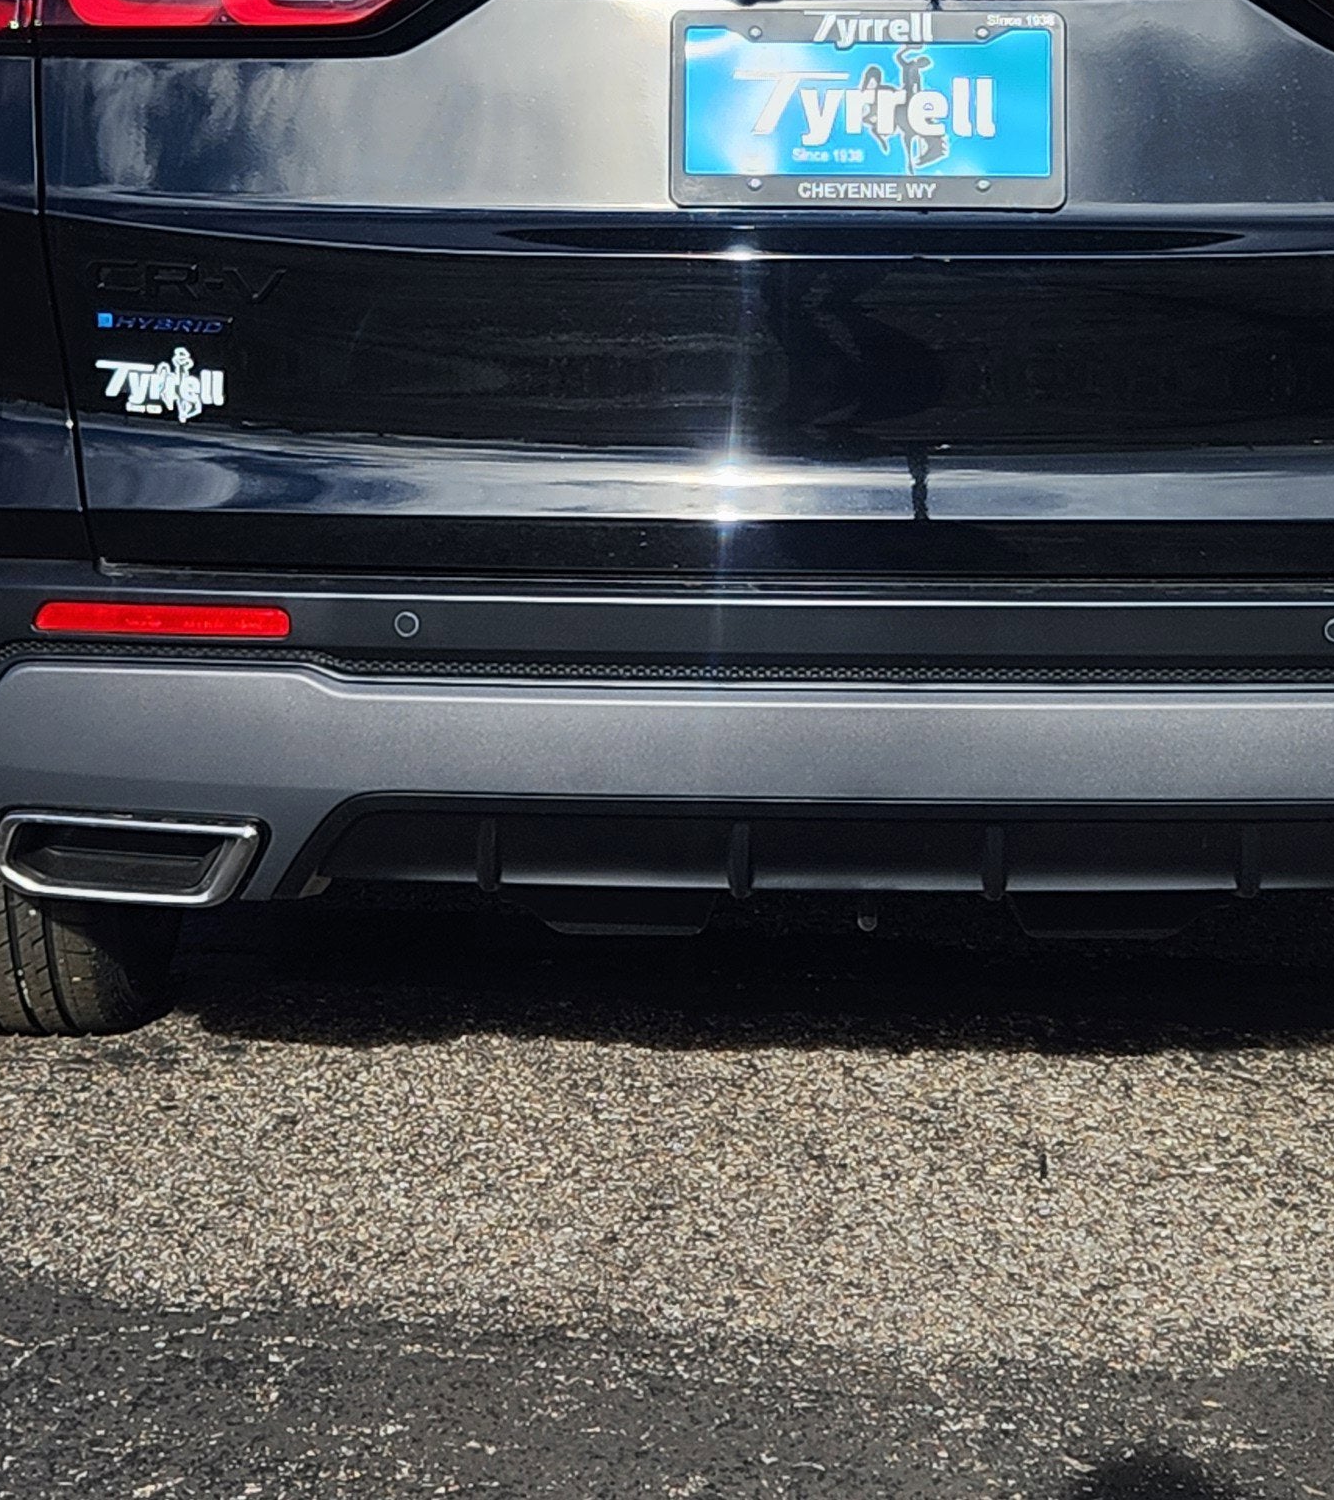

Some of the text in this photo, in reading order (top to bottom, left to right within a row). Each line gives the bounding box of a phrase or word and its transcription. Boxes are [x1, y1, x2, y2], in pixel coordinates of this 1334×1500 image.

[804, 10, 933, 47] Tyrrell
[986, 14, 1022, 27] Since
[733, 69, 996, 146] Tyrrell
[792, 148, 829, 162] Since
[798, 182, 937, 201] CHEYENNE, WY
[86, 259, 287, 304] CR-V
[116, 315, 224, 333] HYBRID
[95, 359, 224, 406] Tyrrell
